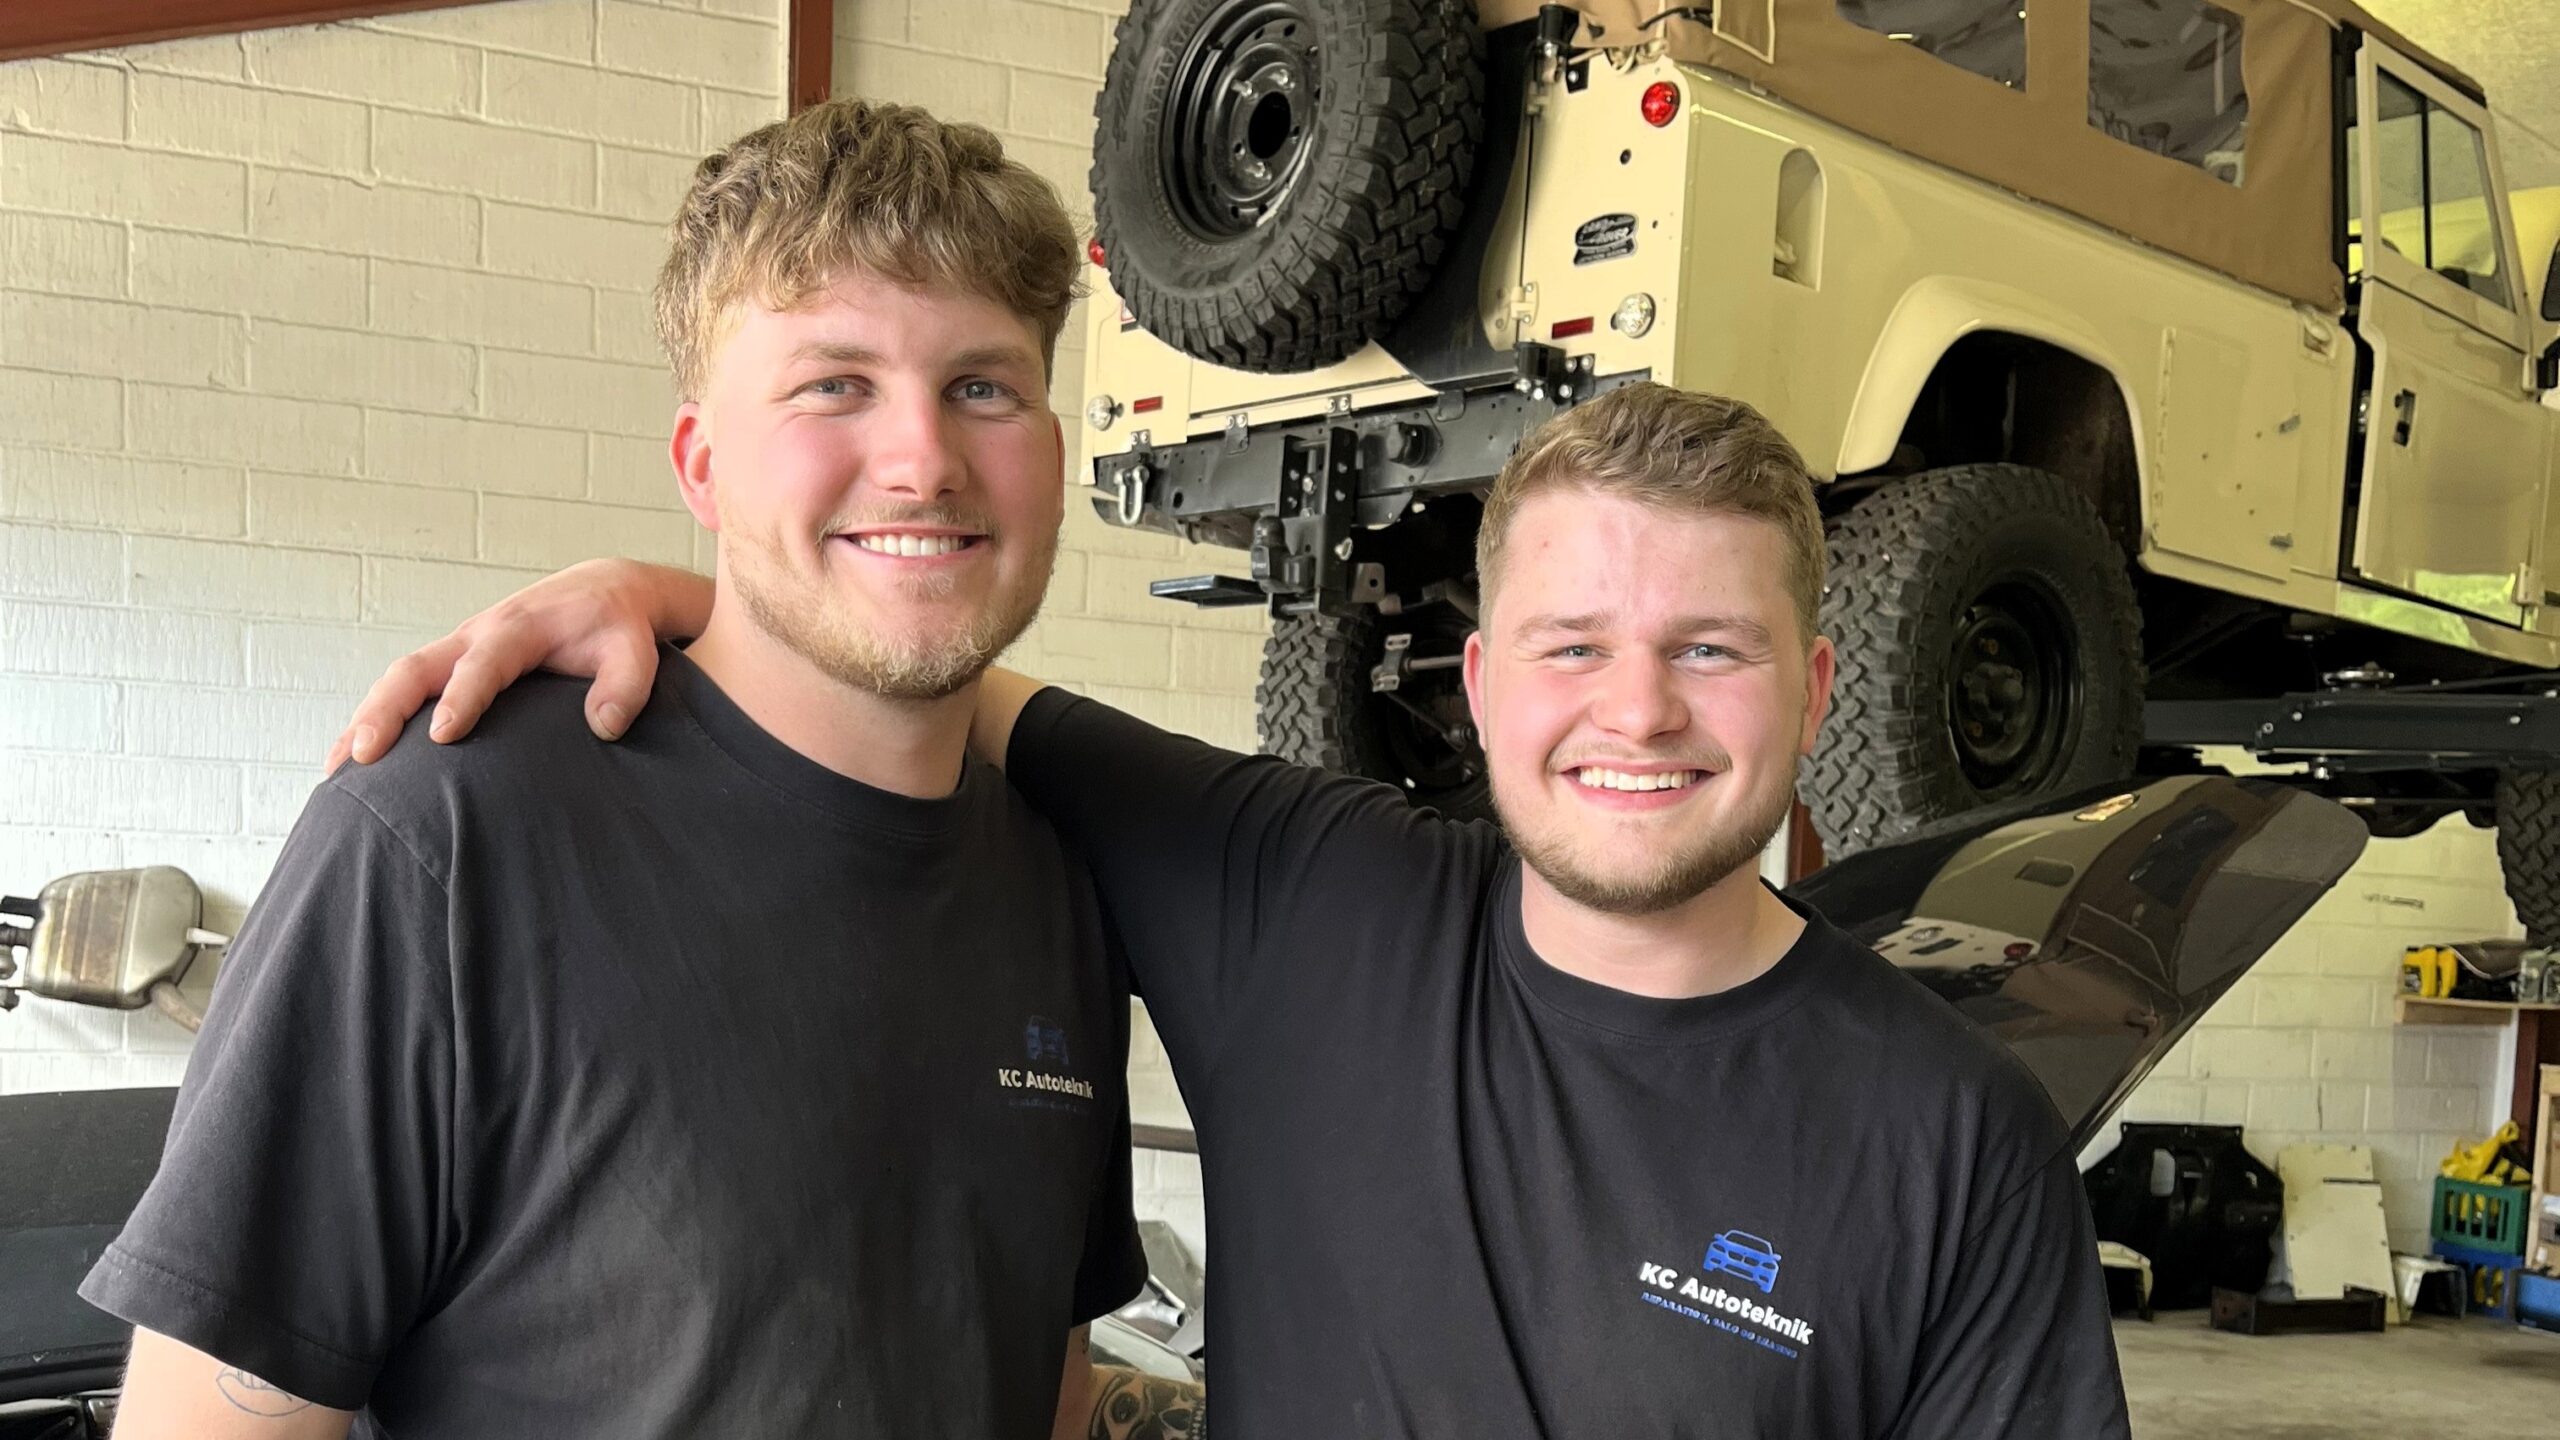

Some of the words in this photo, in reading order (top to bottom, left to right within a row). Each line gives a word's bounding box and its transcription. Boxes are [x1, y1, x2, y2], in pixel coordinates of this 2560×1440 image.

[998, 1068, 1023, 1088] KC
[1026, 1070, 1094, 1099] Autoteknik
[1639, 1262, 1679, 1290] KC
[1680, 1277, 1815, 1346] Autoteknik
